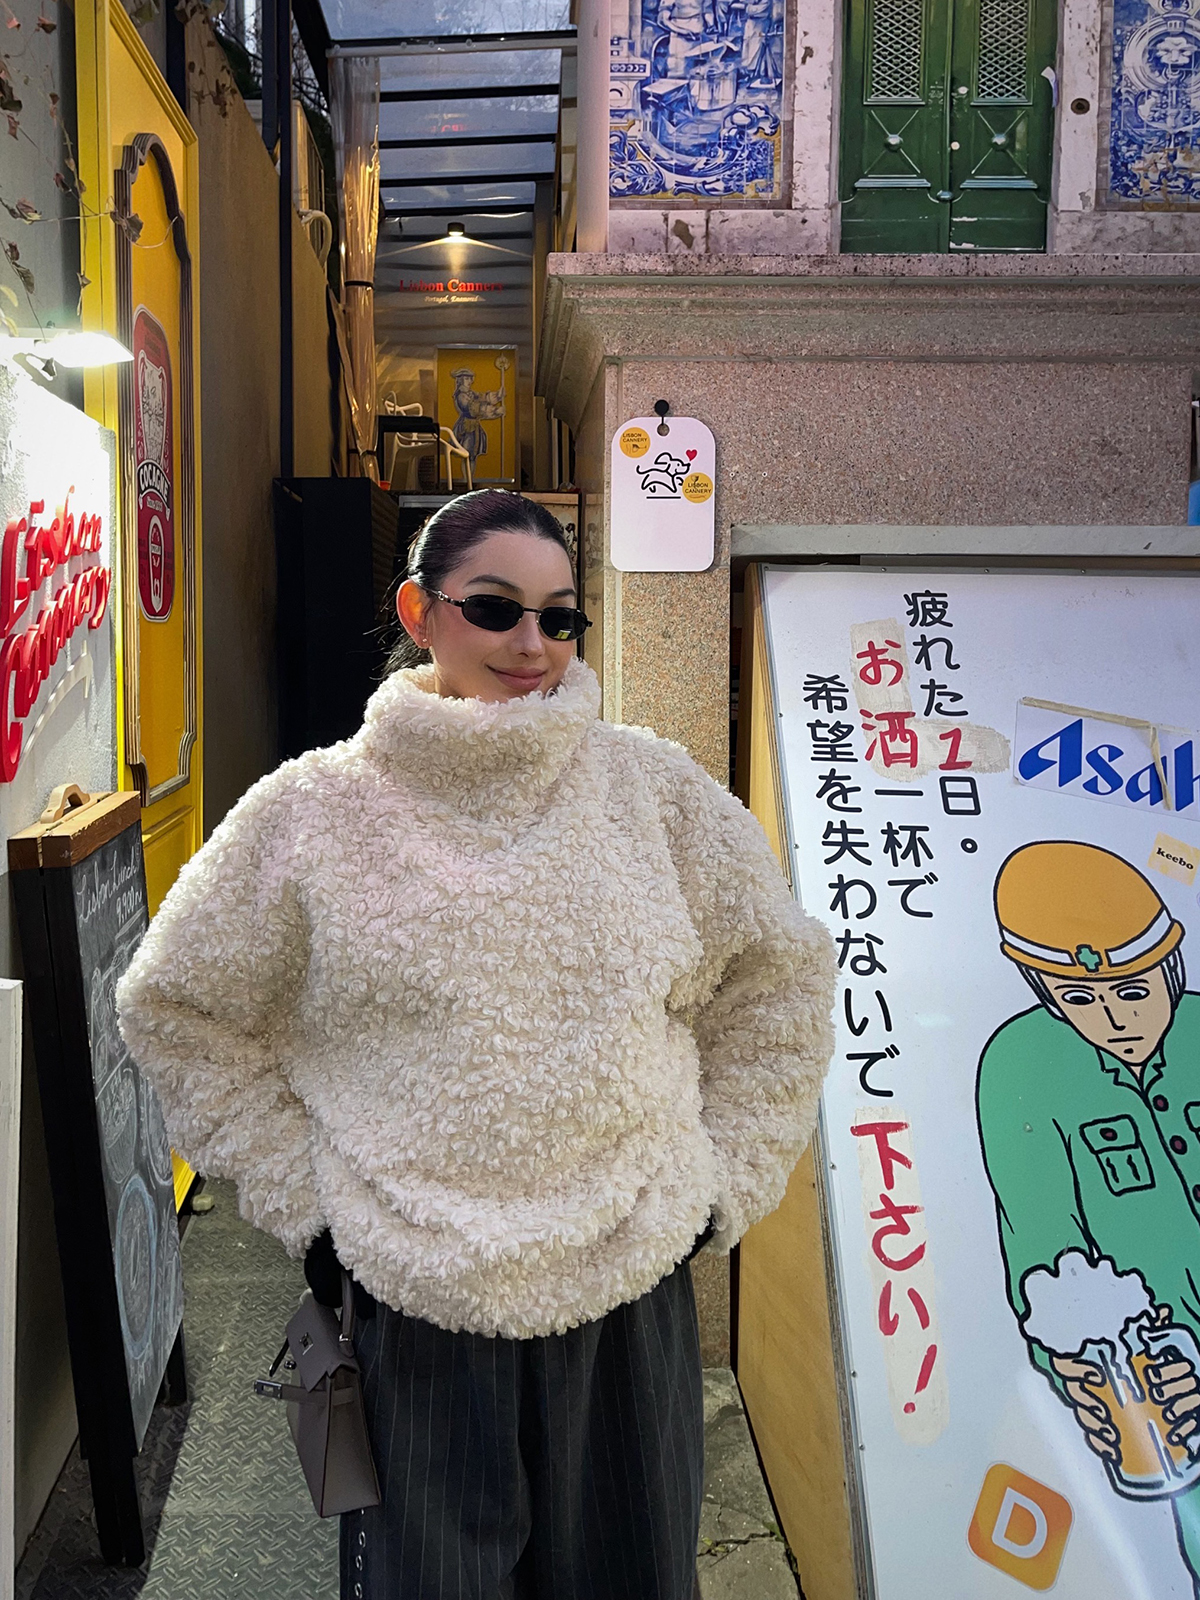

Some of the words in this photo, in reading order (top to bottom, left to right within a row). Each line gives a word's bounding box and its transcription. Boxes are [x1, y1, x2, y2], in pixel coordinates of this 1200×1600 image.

[400, 279, 444, 293] Lisbon
[447, 278, 504, 295] Cannery
[139, 463, 169, 503] COCAGNE
[0, 485, 102, 639] Lisbon
[0, 565, 111, 783] Cannery
[856, 639, 939, 919] お酒一杯で
[1156, 847, 1194, 870] keebo
[991, 1486, 1048, 1559] D
